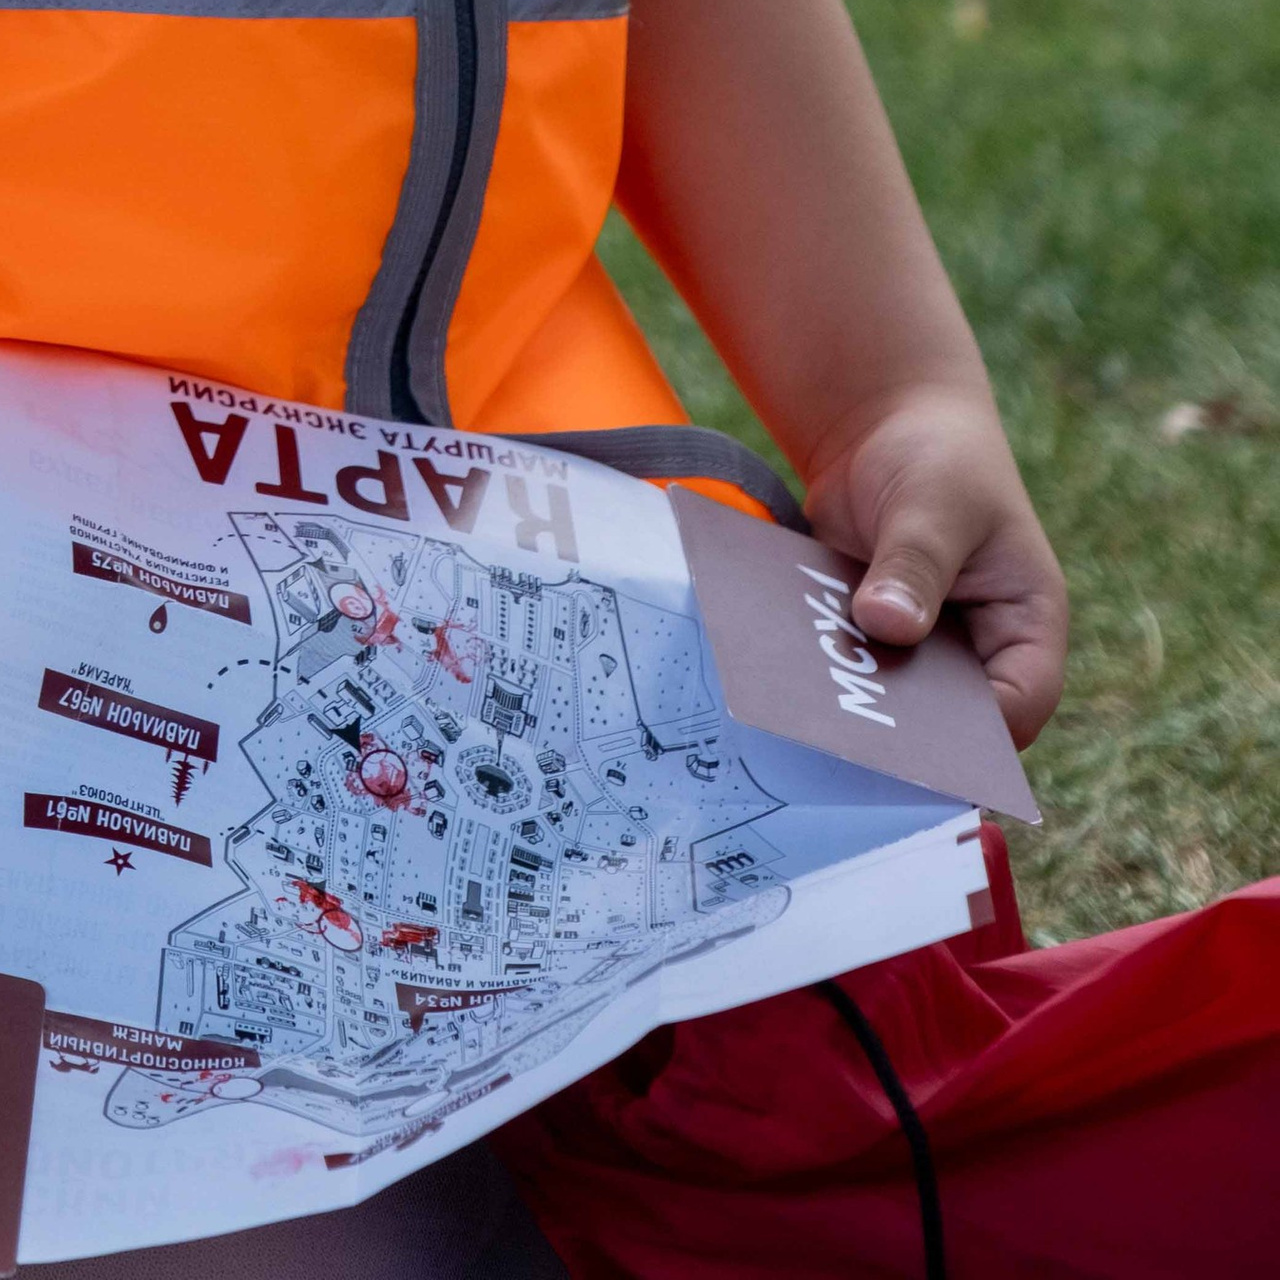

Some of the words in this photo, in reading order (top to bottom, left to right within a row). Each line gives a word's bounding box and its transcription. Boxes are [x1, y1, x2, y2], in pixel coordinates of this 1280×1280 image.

[167, 376, 368, 441] ЭКСКУРСИИ
[379, 428, 570, 482] МАРШРУТА
[170, 401, 581, 565] КАРТА
[72, 514, 118, 537] ГРУППЫ
[70, 526, 142, 564] УЧАСТНИКОВ
[121, 533, 216, 574] ФОРМИРОВАНИЕ
[91, 551, 134, 577] №75
[145, 559, 229, 587] РЕГИСТРАЦИЯ
[219, 566, 229, 575] И
[139, 570, 229, 609] ПАВИЛЬОН
[796, 563, 897, 728] МСУ-1
[71, 662, 135, 695] "КАРЕЛИЯ"
[58, 687, 104, 717] №67
[106, 702, 201, 749] ПАВИЛЬОН
[45, 800, 91, 823] №61
[72, 785, 165, 822] "ЦЕНТРОСОЮЗ"
[96, 809, 192, 851] ПАВИЛЬОН
[415, 992, 462, 1007] №34
[50, 1032, 245, 1070] КОННОСПОРТИВНЫЙ
[112, 1025, 183, 1051] МАНЕЖ
